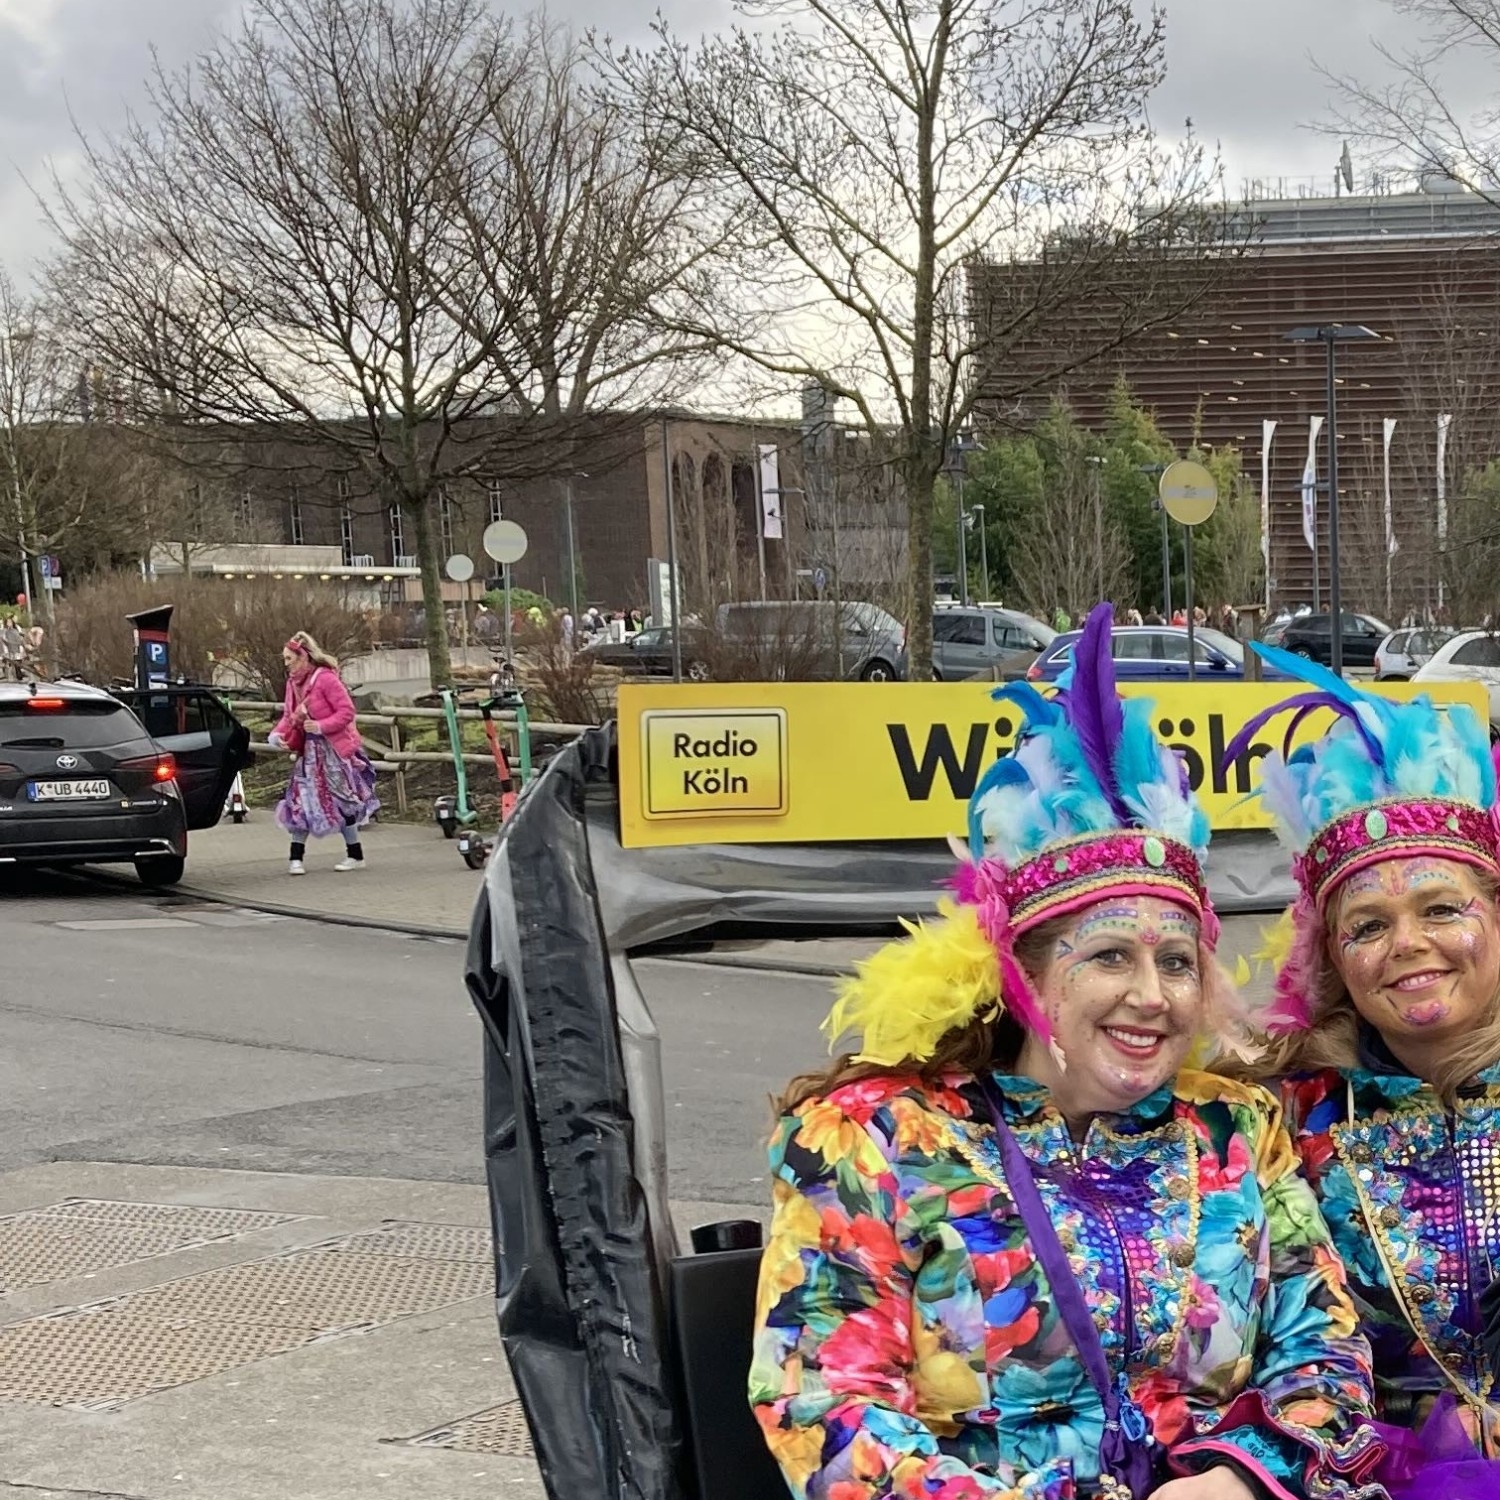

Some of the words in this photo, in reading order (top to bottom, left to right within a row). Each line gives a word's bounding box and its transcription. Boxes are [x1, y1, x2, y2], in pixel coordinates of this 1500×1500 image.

[150, 643, 163, 661] P
[673, 729, 758, 758] Radio
[886, 716, 1014, 801] Wi
[55, 782, 72, 796] UB
[75, 781, 107, 795] 4440
[683, 767, 748, 795] Köln
